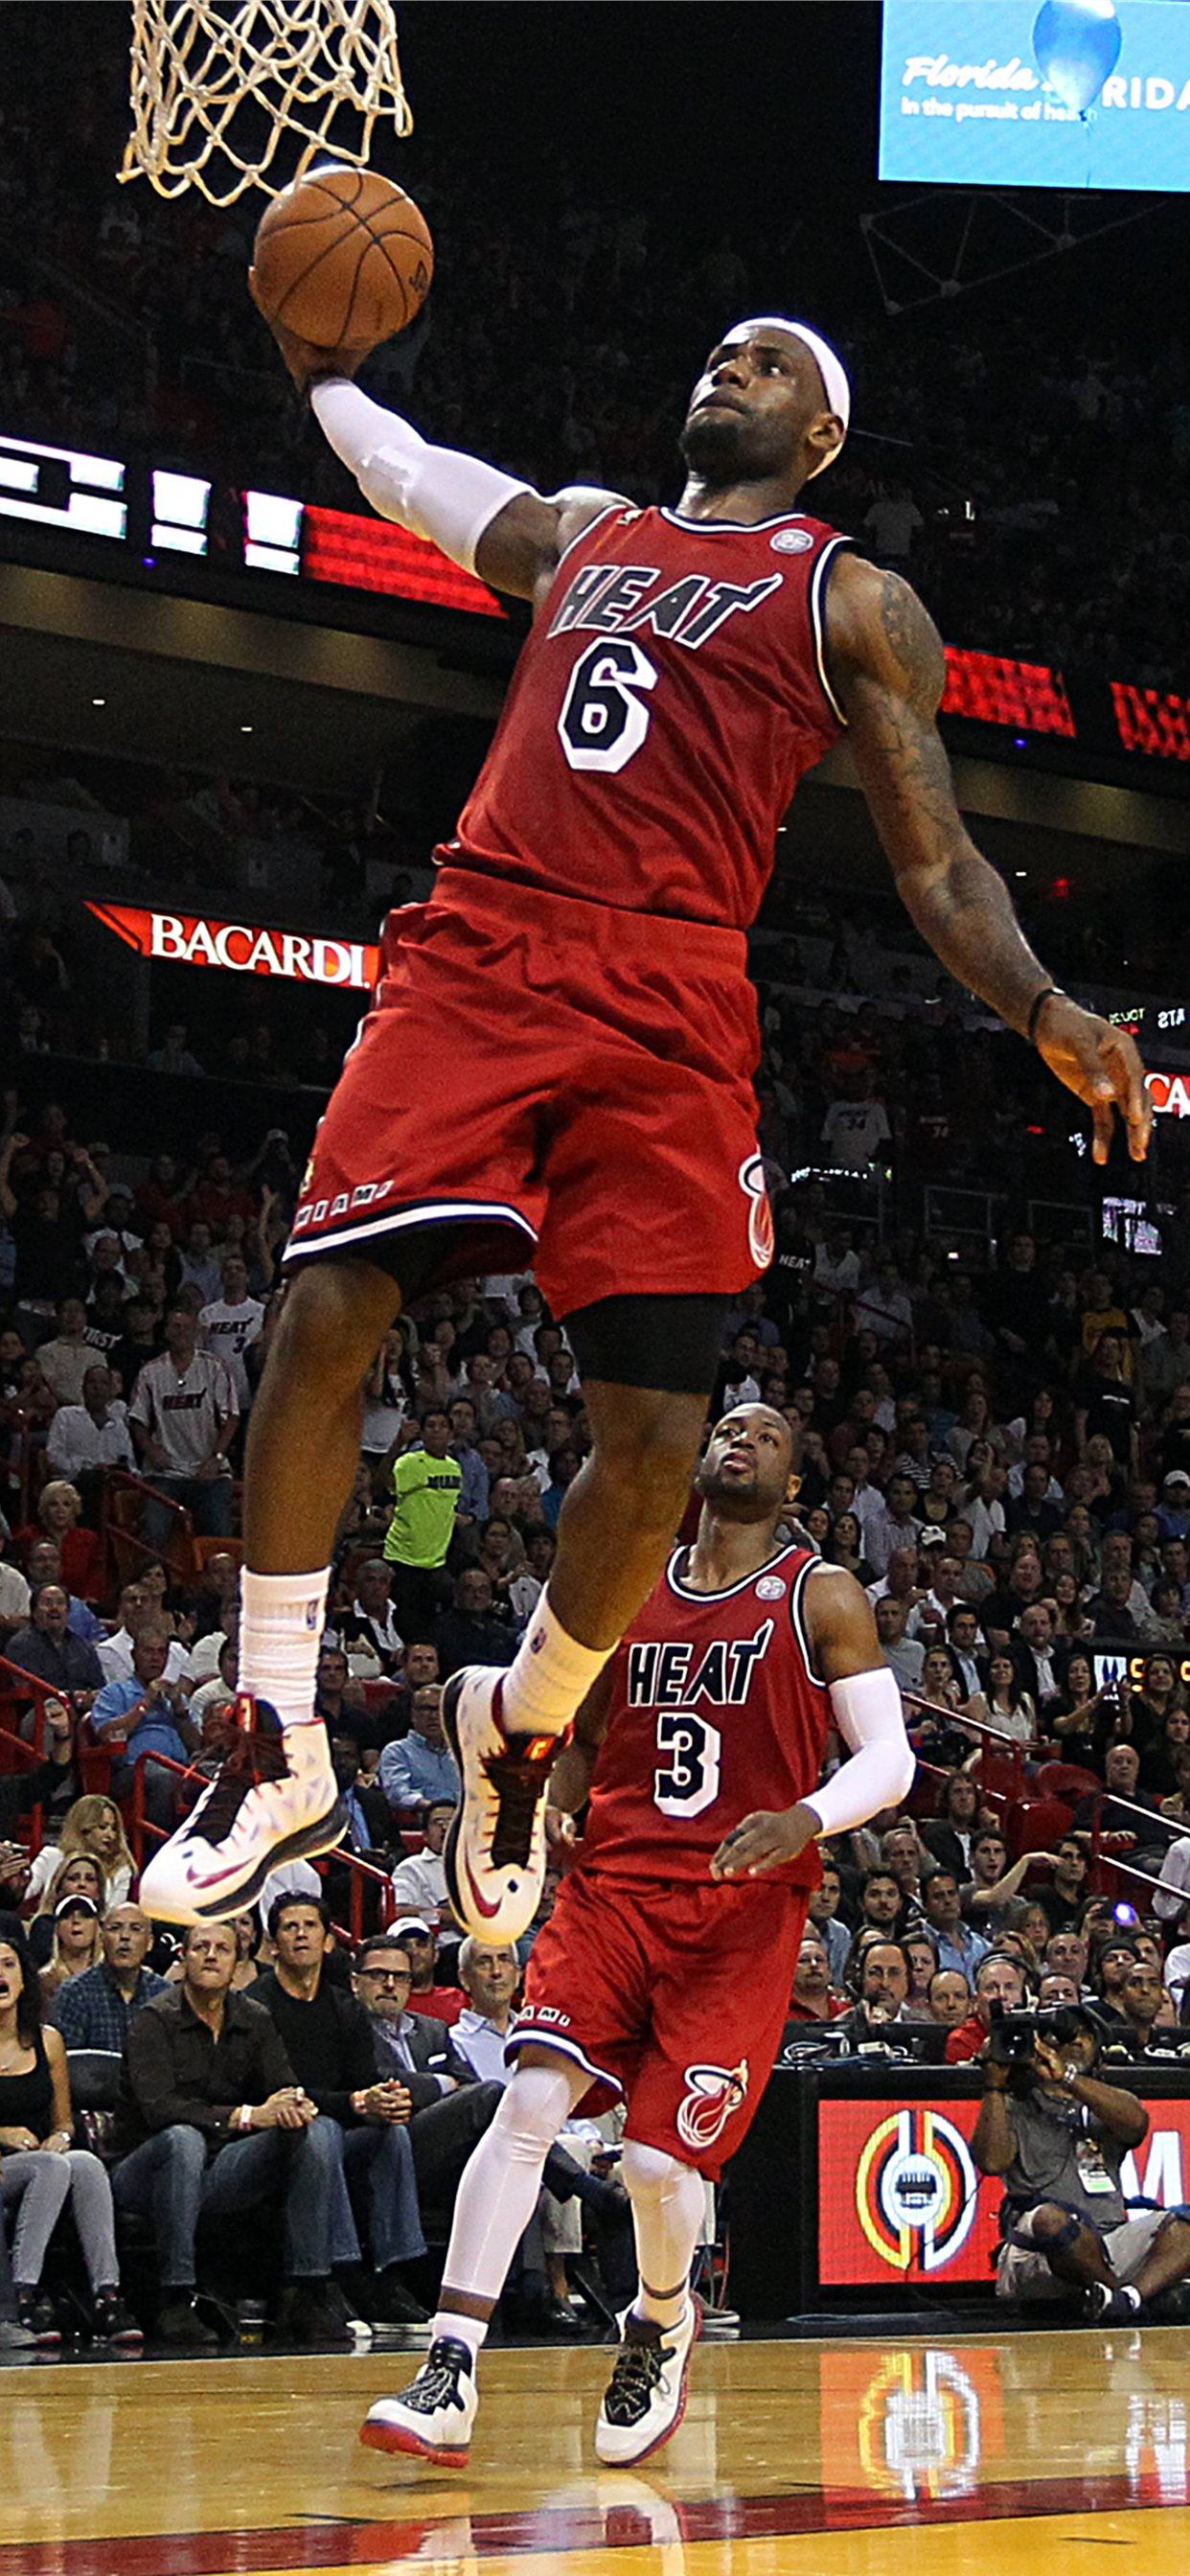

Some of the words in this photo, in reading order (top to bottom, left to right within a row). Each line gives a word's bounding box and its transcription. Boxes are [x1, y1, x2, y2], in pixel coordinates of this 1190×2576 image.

[902, 54, 1040, 91] Florida
[901, 96, 920, 115] In
[922, 97, 953, 117] the
[955, 101, 1018, 123] pursuit
[1020, 101, 1042, 121] of
[546, 564, 784, 650] HEAT
[558, 636, 659, 773] 6
[208, 1317, 255, 1335] HEAT
[233, 1336, 246, 1354] 3
[628, 1618, 774, 1708] HEAT
[653, 1712, 721, 1818] 3
